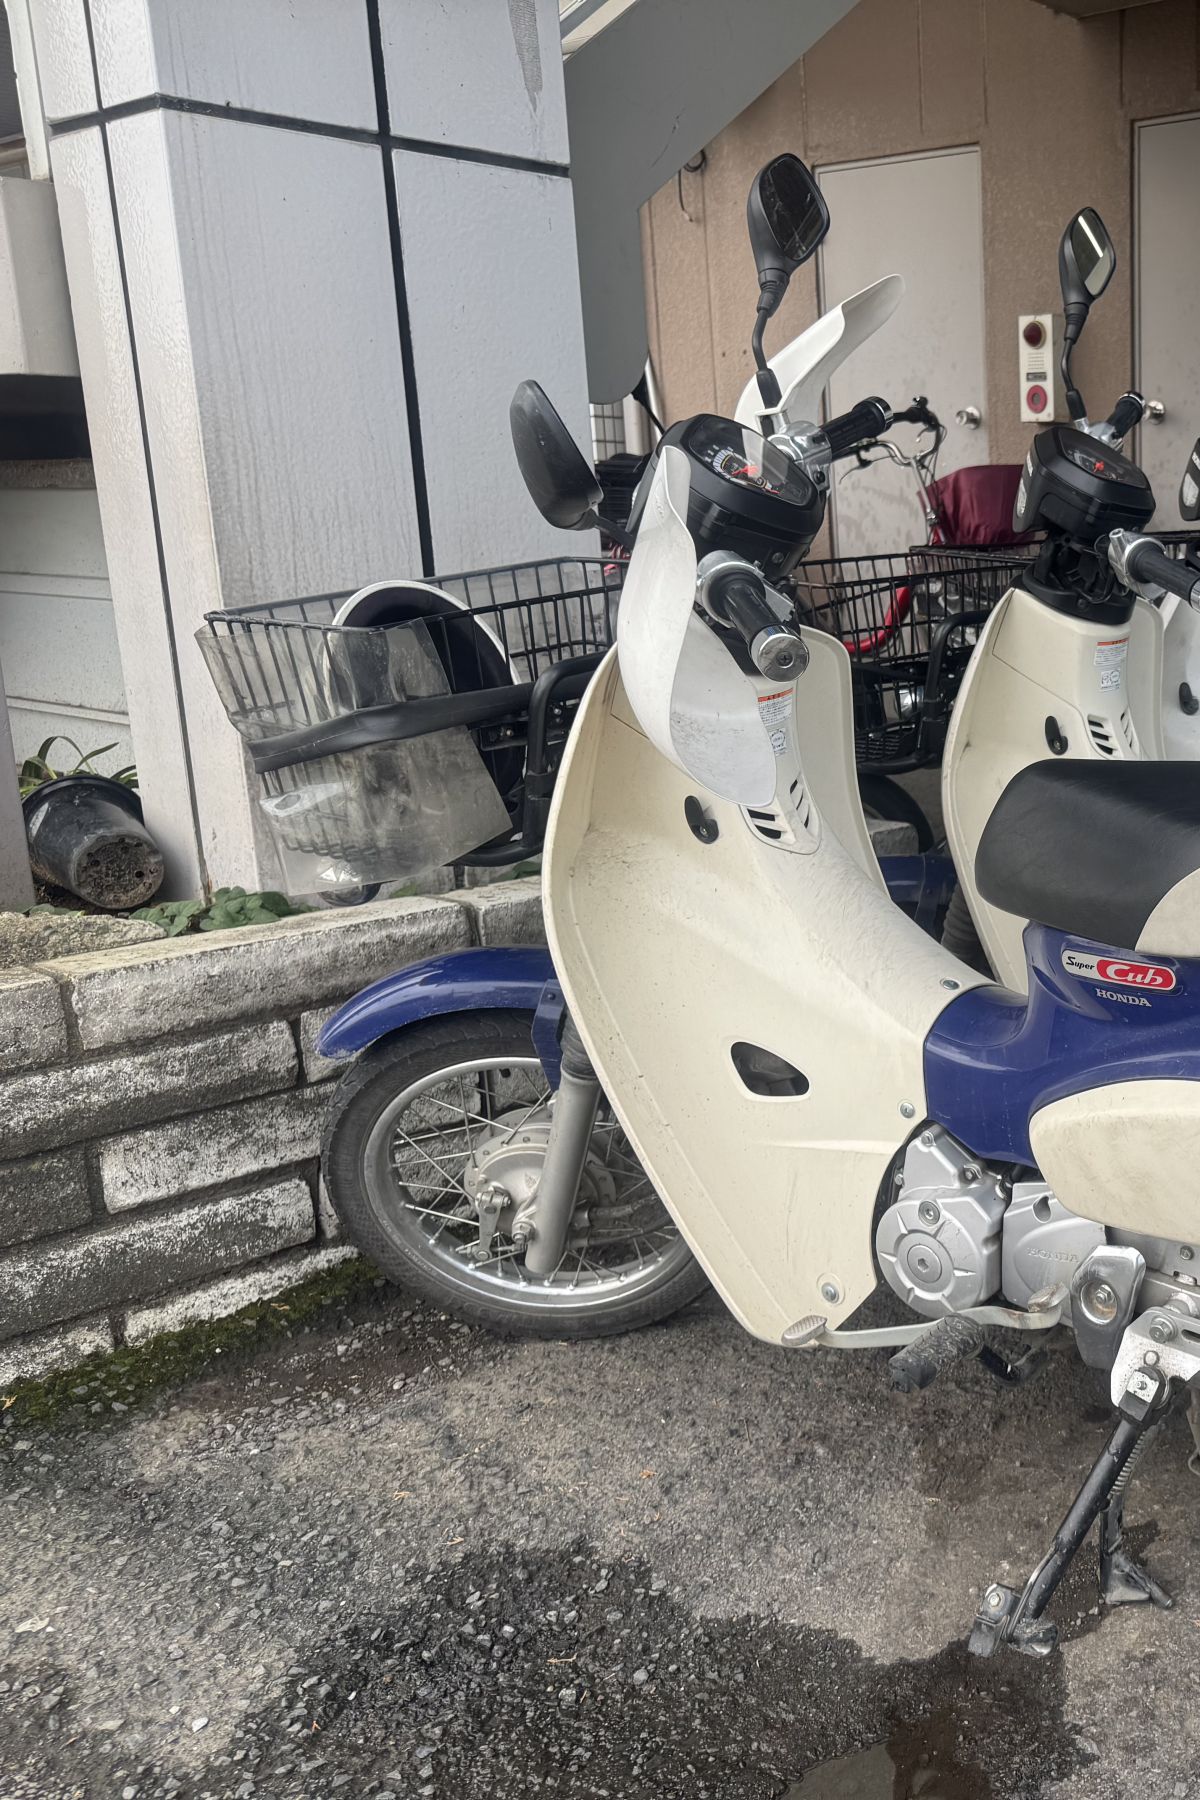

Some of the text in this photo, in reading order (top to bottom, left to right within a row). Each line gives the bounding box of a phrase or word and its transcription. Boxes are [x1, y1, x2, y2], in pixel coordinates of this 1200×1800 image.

[1066, 956, 1163, 985] Super Cub
[1095, 988, 1152, 1007] HONDA
